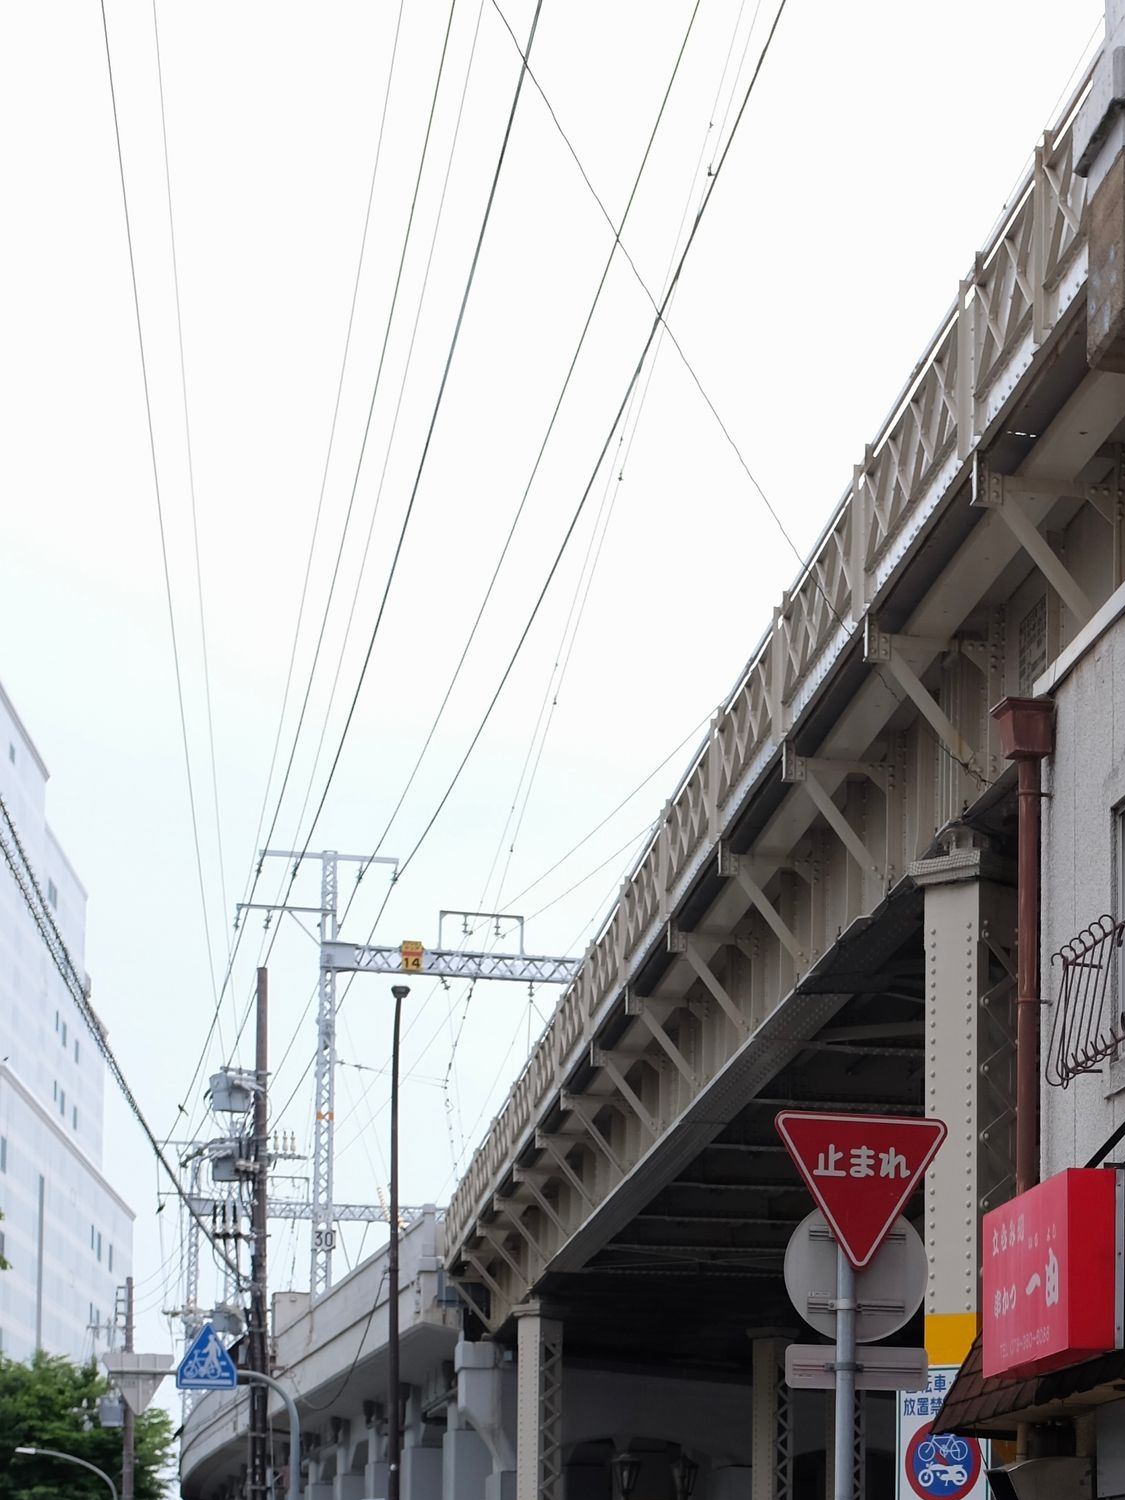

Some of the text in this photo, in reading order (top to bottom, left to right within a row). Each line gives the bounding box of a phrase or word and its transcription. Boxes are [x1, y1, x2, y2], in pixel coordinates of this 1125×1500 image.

[404, 957, 421, 969] 14
[813, 1144, 911, 1179] 止まれ
[314, 1230, 333, 1247] 30
